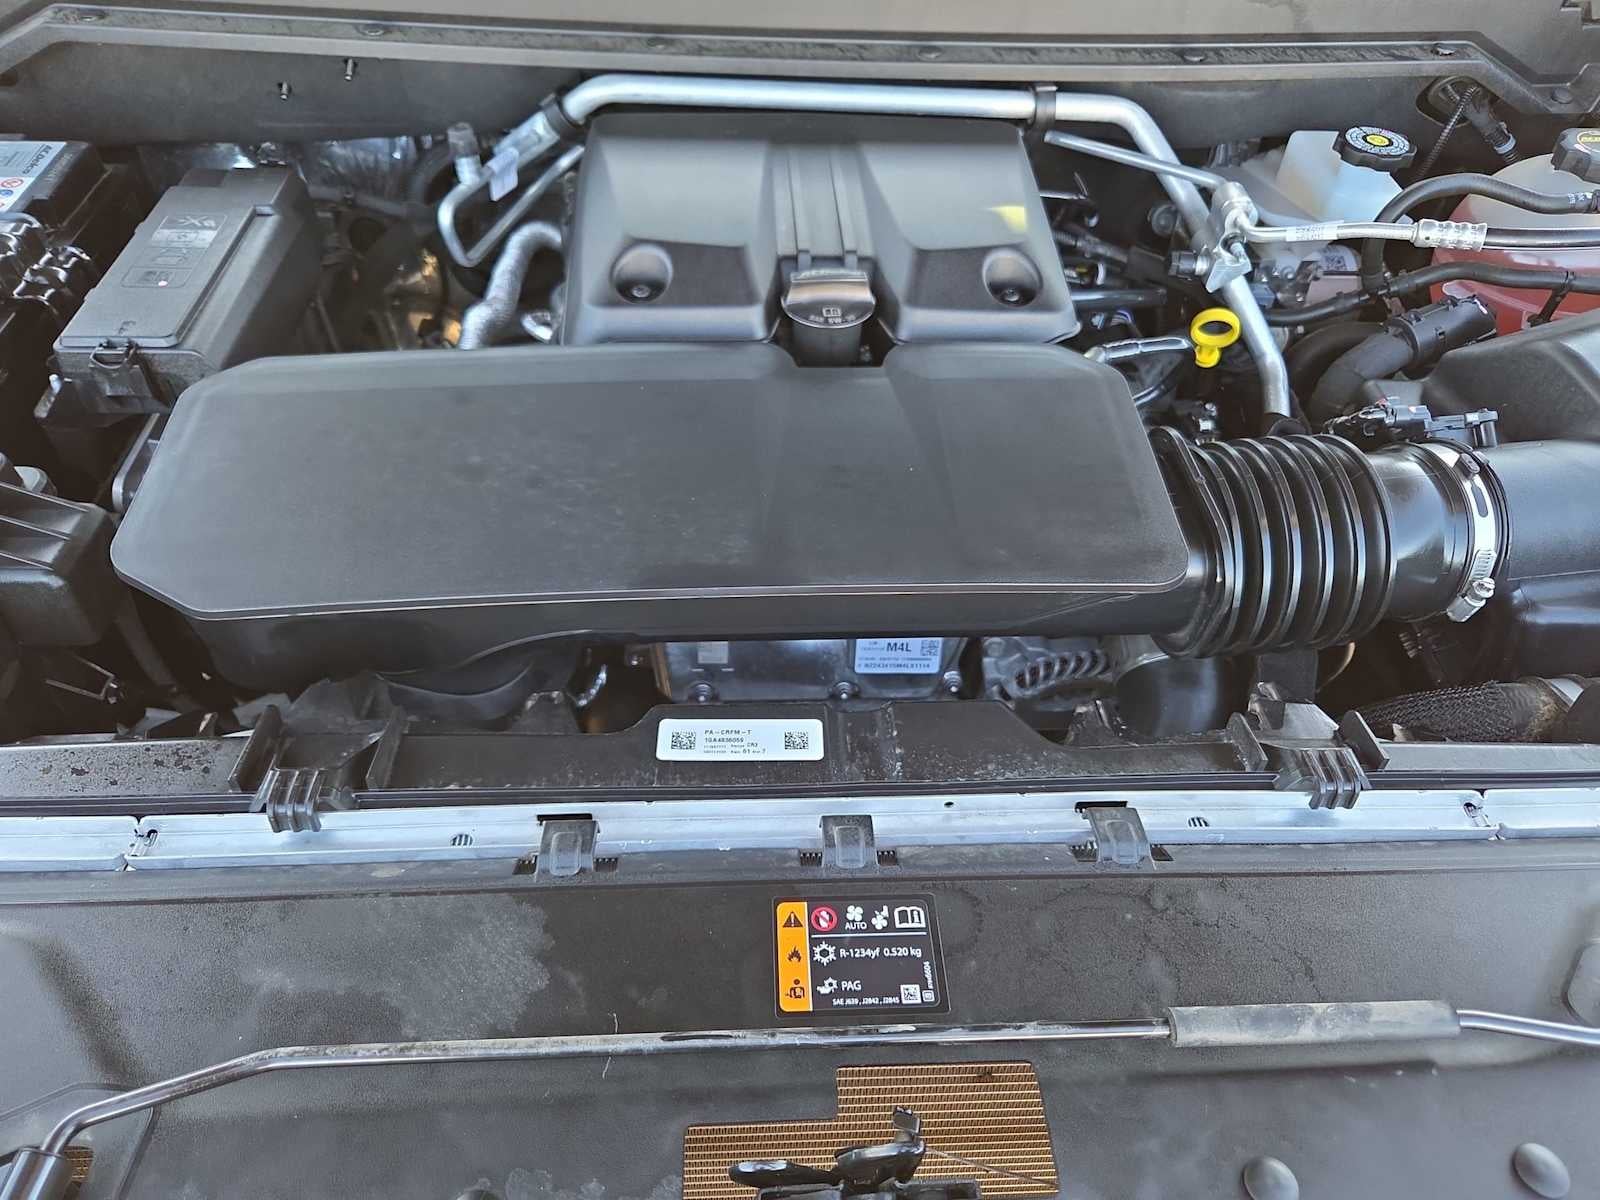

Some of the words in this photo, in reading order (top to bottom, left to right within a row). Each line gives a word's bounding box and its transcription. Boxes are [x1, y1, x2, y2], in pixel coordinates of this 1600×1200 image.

[886, 642, 912, 652] M4L
[845, 922, 867, 930] AUTO
[840, 948, 880, 959] R-1234yf
[884, 947, 909, 957] 0.520
[910, 946, 922, 957] kg
[842, 981, 861, 991] PAG
[832, 998, 844, 1006] SAE
